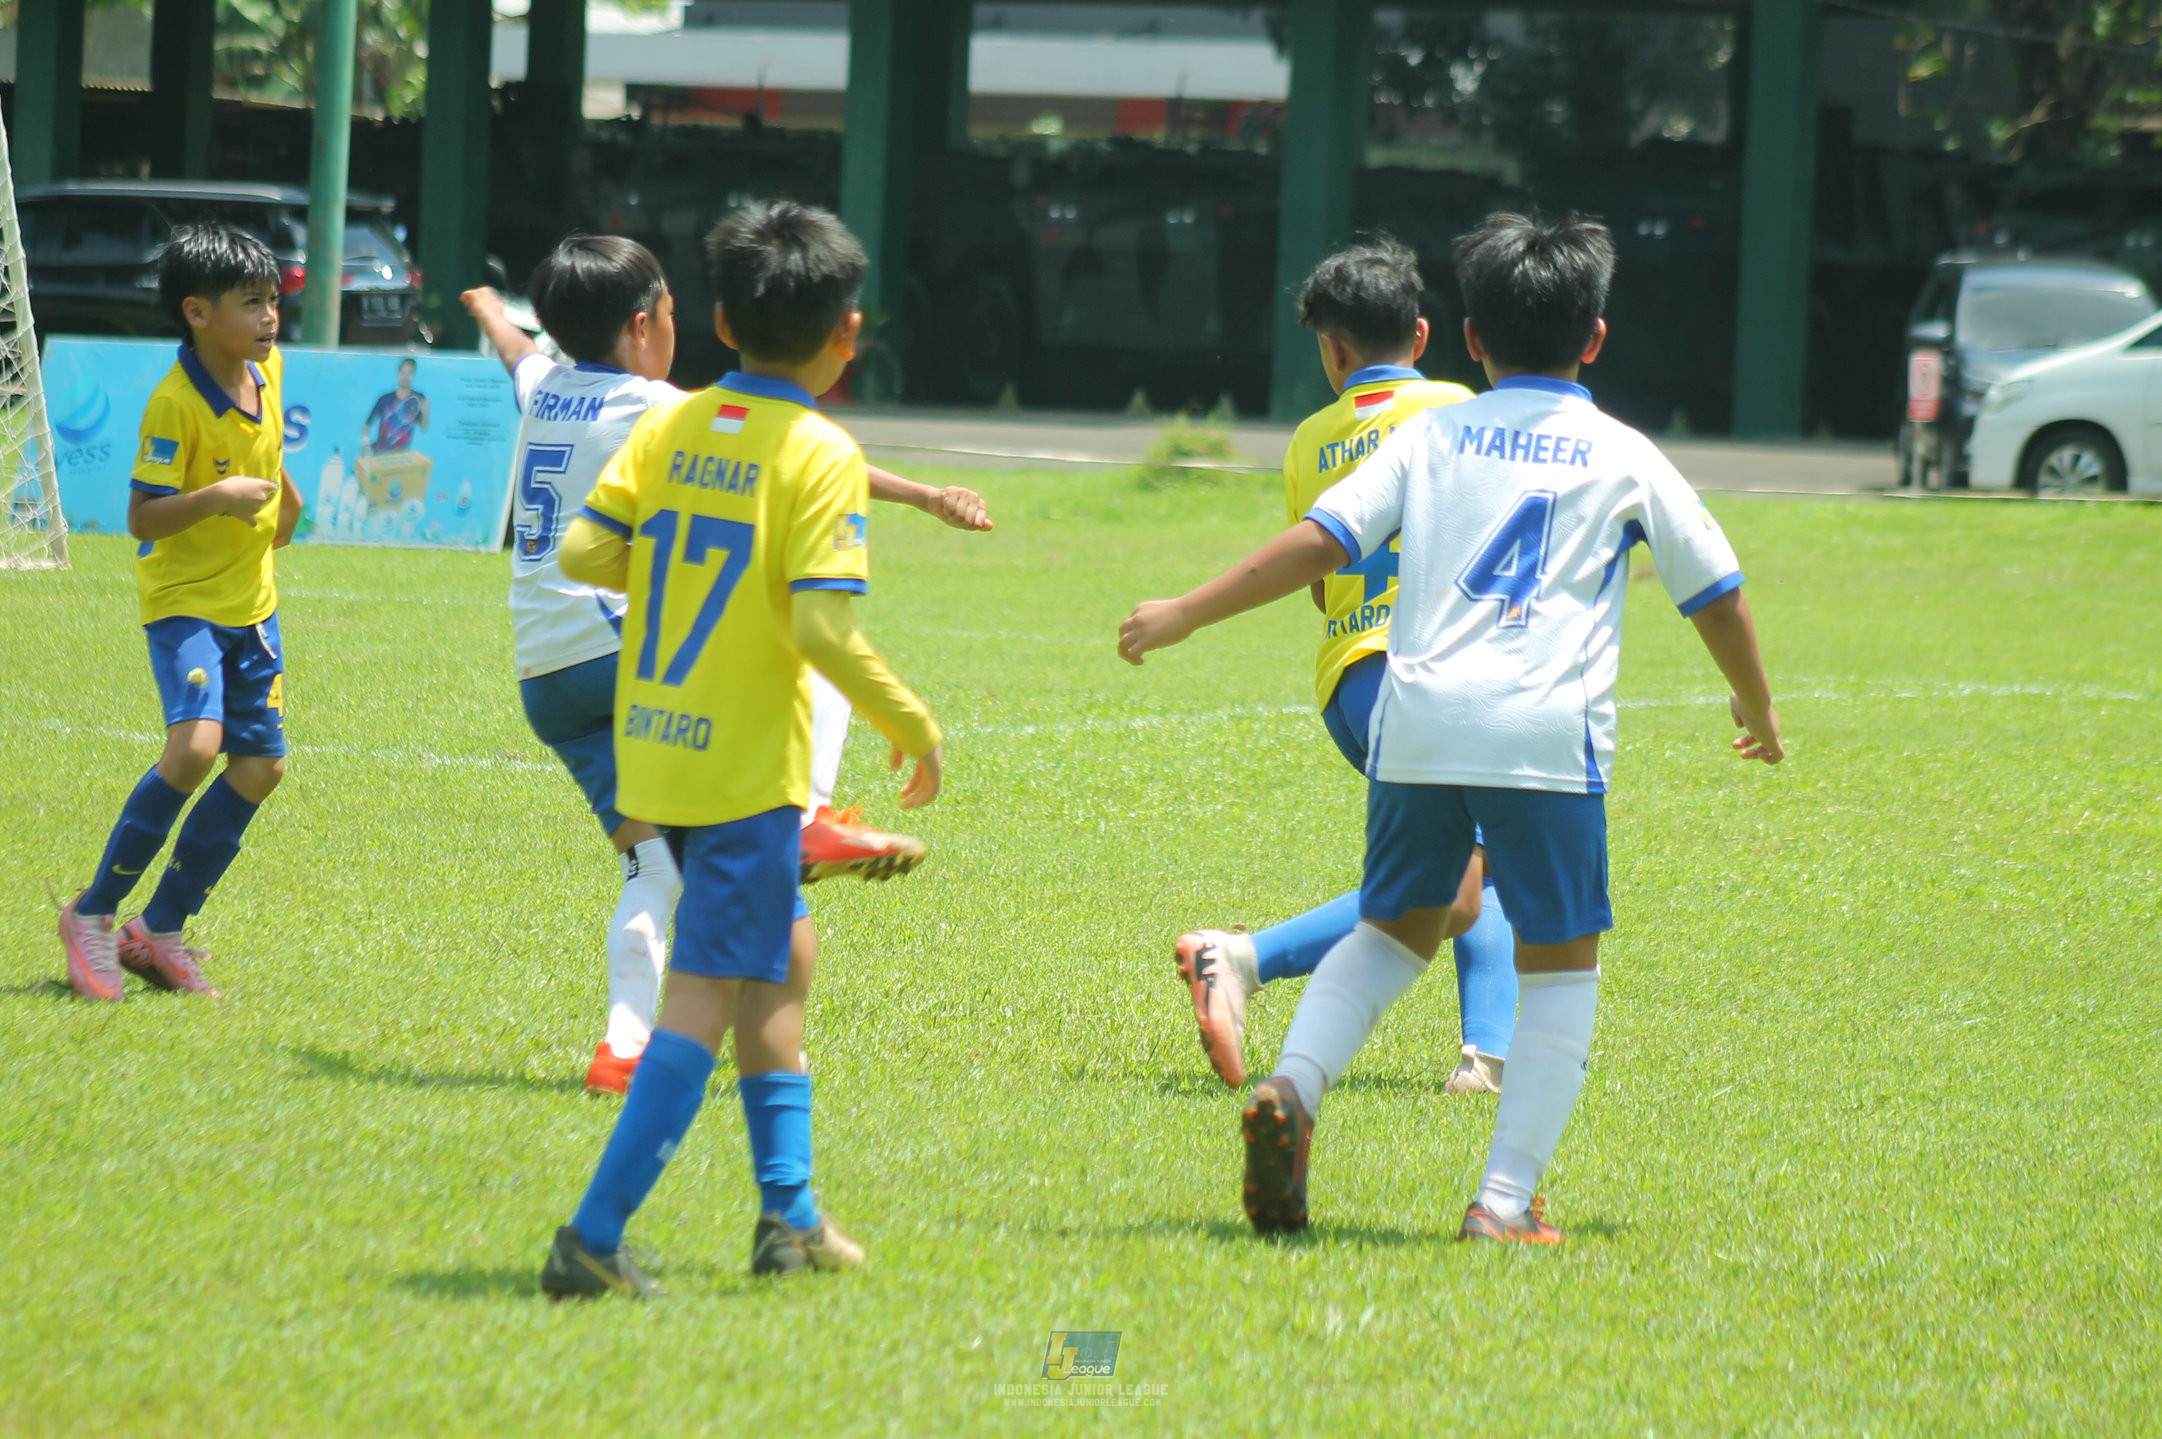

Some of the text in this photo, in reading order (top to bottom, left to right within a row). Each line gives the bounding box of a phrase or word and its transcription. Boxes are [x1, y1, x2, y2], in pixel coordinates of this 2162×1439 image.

[529, 390, 605, 421] FIRMAN
[1318, 429, 1379, 473] ATHAR
[1459, 425, 1593, 468] MAHEER
[668, 450, 759, 497] RAGNAR
[516, 442, 574, 562] 5
[1456, 490, 1558, 628] 4
[636, 508, 755, 688] 17
[624, 704, 712, 751] BINTARO
